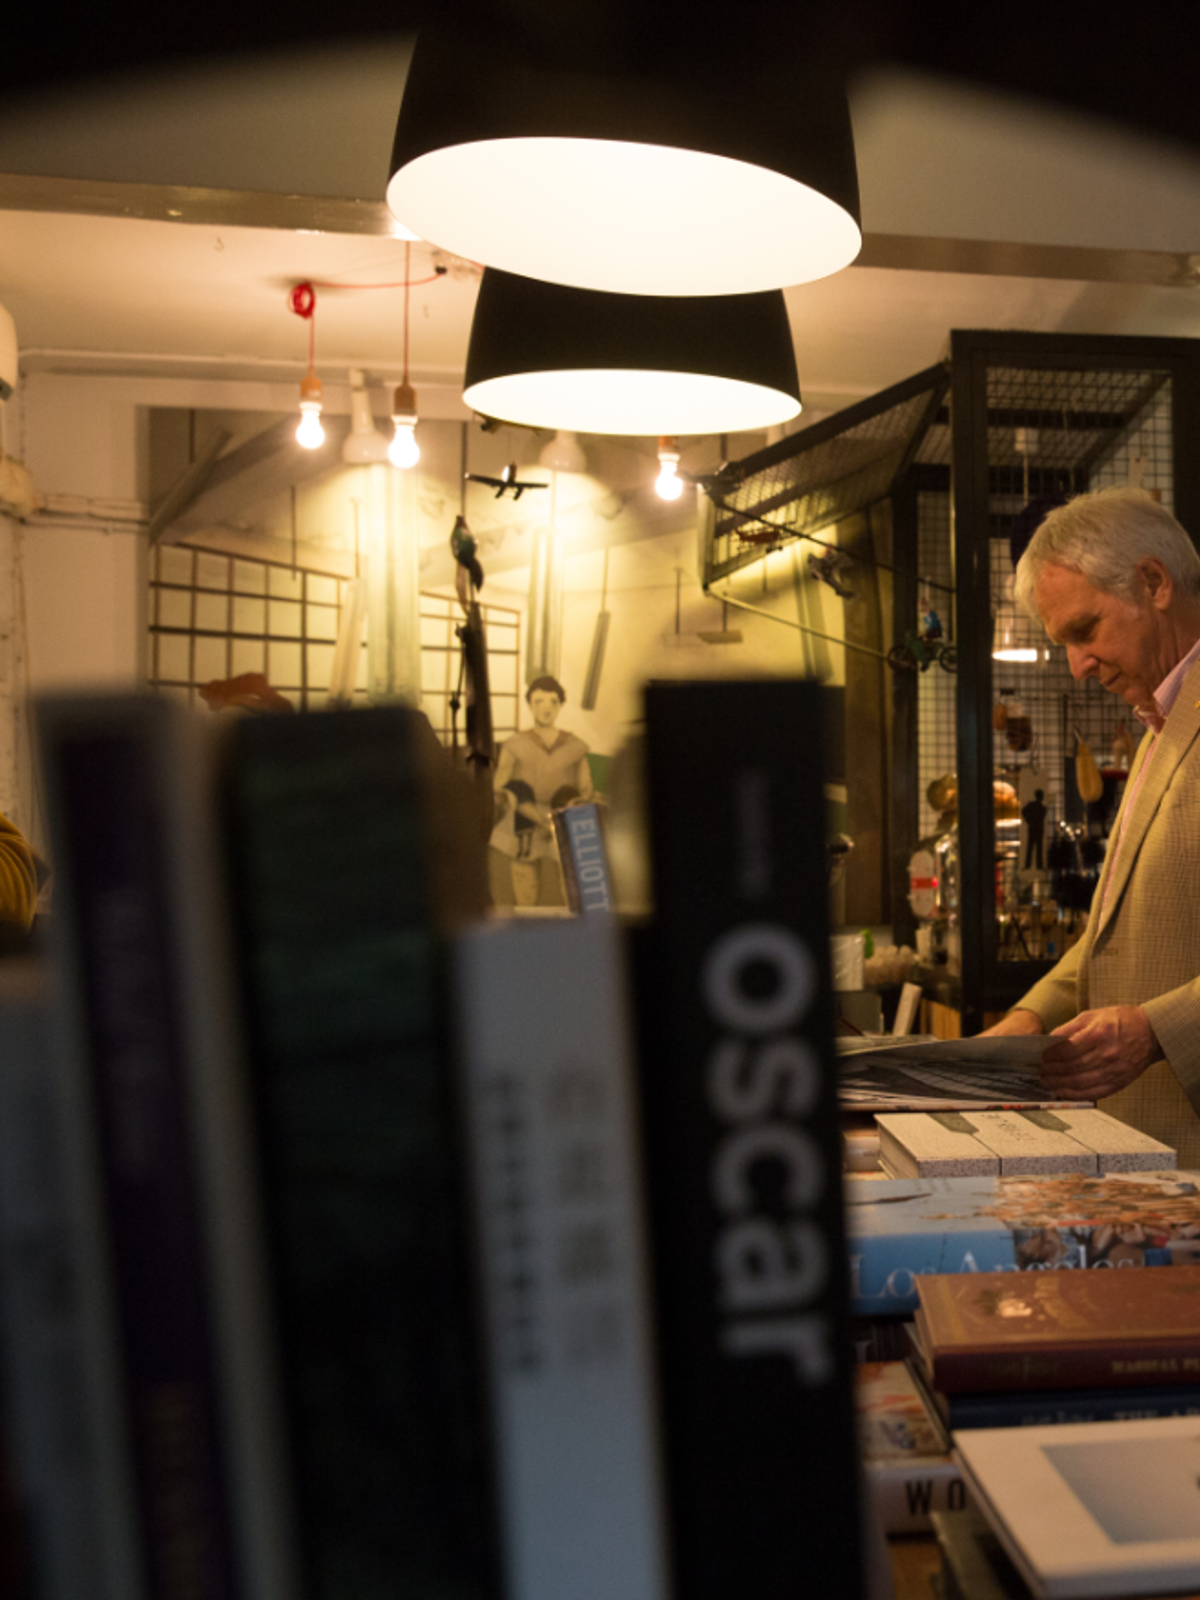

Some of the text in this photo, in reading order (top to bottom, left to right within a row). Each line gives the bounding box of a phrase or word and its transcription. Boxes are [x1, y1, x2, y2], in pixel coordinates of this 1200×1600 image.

[571, 819, 610, 911] ELLIOTT
[700, 920, 838, 1390] oscar
[849, 1253, 937, 1298] Lo
